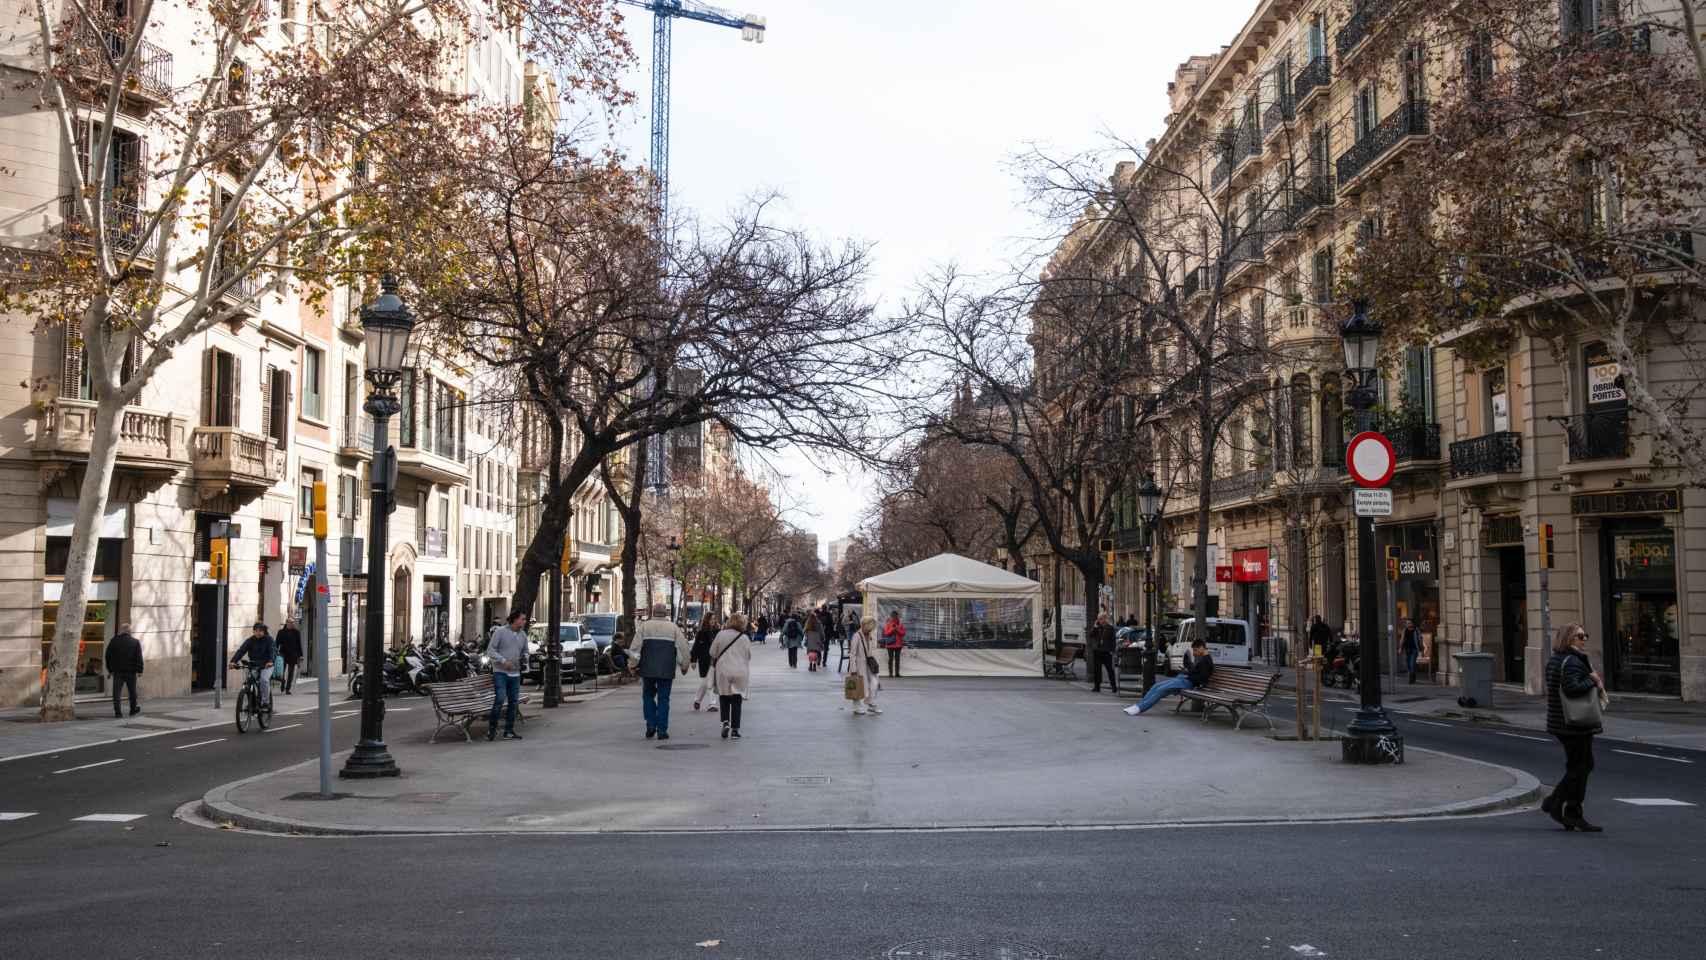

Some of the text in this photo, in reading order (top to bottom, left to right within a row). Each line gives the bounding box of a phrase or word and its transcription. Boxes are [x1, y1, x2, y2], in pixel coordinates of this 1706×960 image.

[1593, 365, 1618, 378] 100
[1592, 390, 1622, 400] PORTES
[1399, 558, 1431, 575] casa viva
